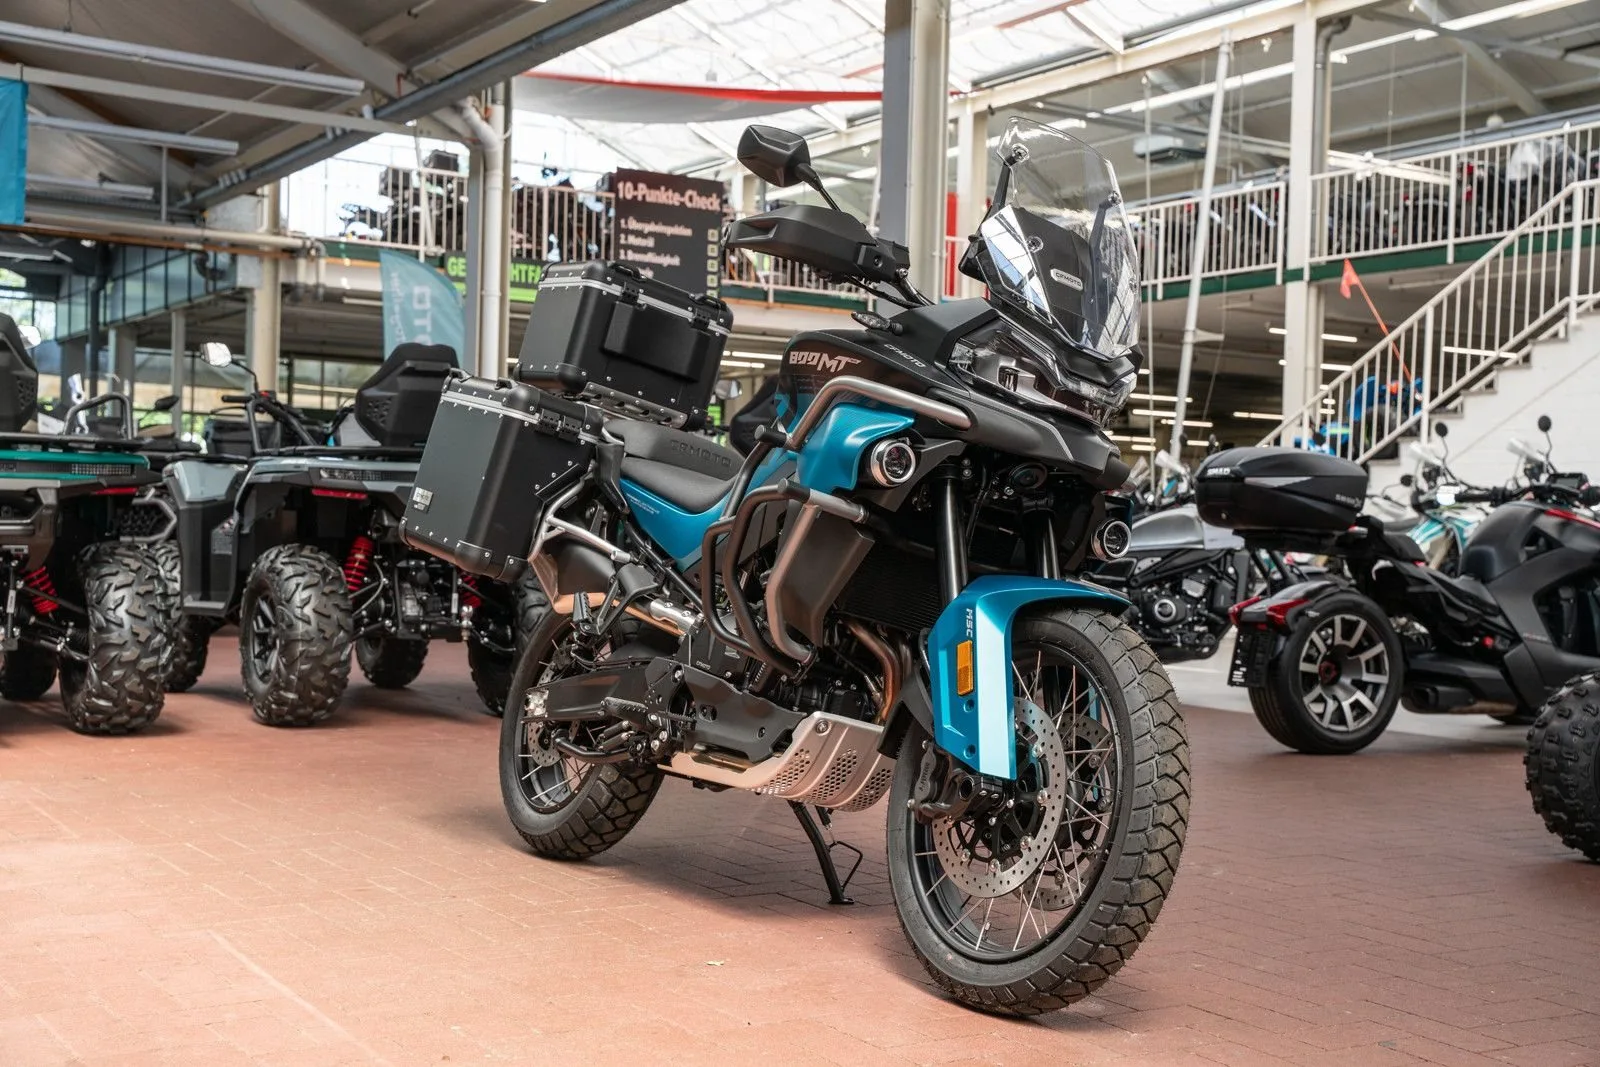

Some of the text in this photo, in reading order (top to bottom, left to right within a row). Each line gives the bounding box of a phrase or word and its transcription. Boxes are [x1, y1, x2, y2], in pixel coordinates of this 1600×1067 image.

[617, 181, 720, 211] 10-Punkte-Check
[789, 351, 862, 373] 800MT
[884, 343, 927, 368] CFMOTO
